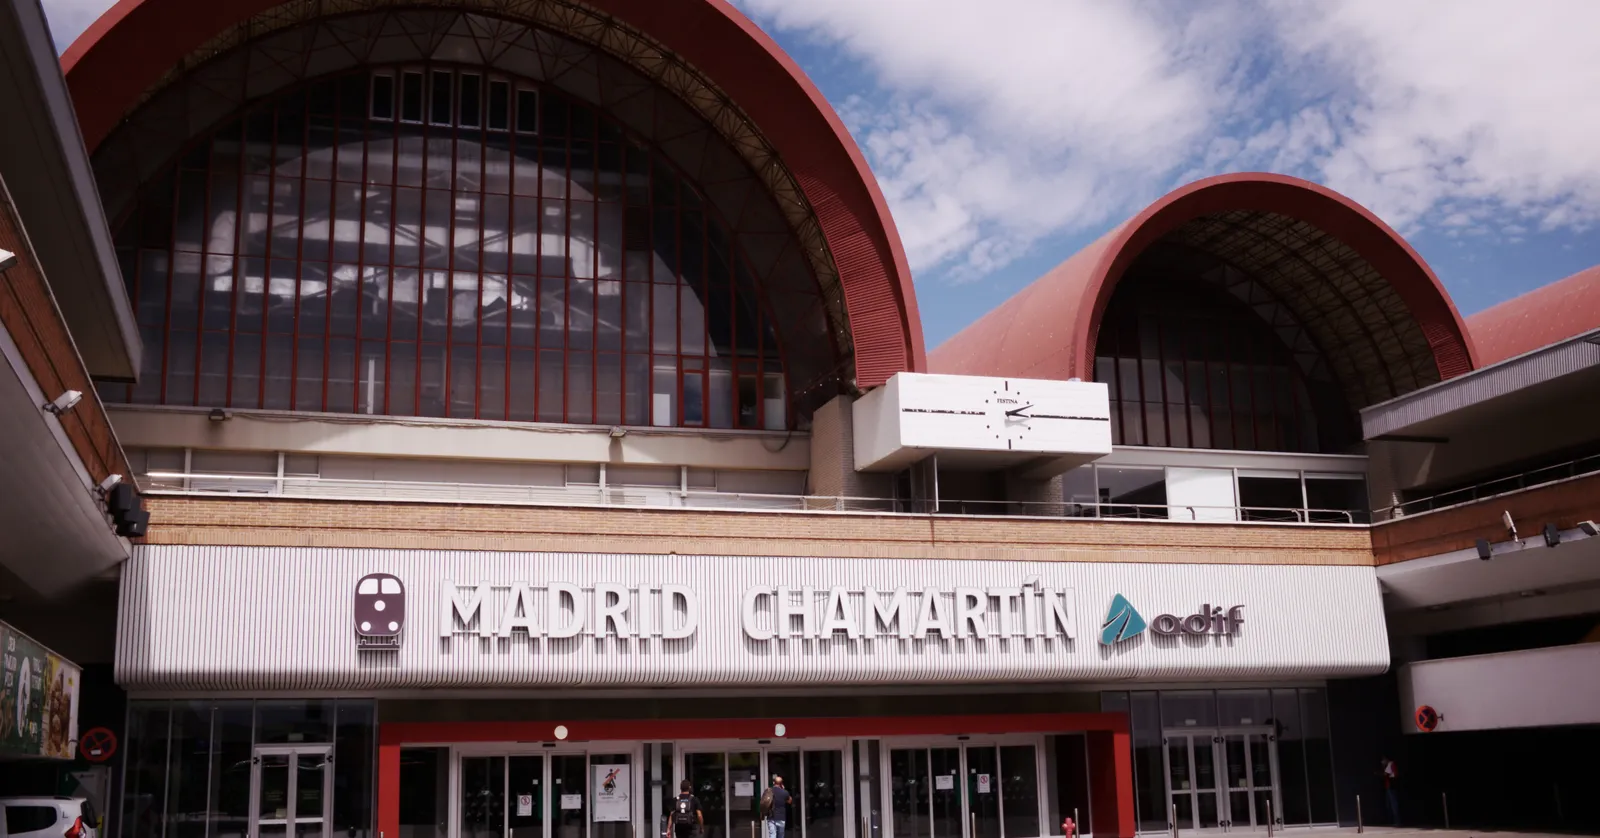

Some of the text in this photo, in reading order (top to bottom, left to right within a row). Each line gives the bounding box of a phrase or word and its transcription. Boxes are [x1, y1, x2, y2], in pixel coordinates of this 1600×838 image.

[440, 574, 1075, 640] MADRID CHAMARTÍN
[1152, 603, 1246, 635] adif
